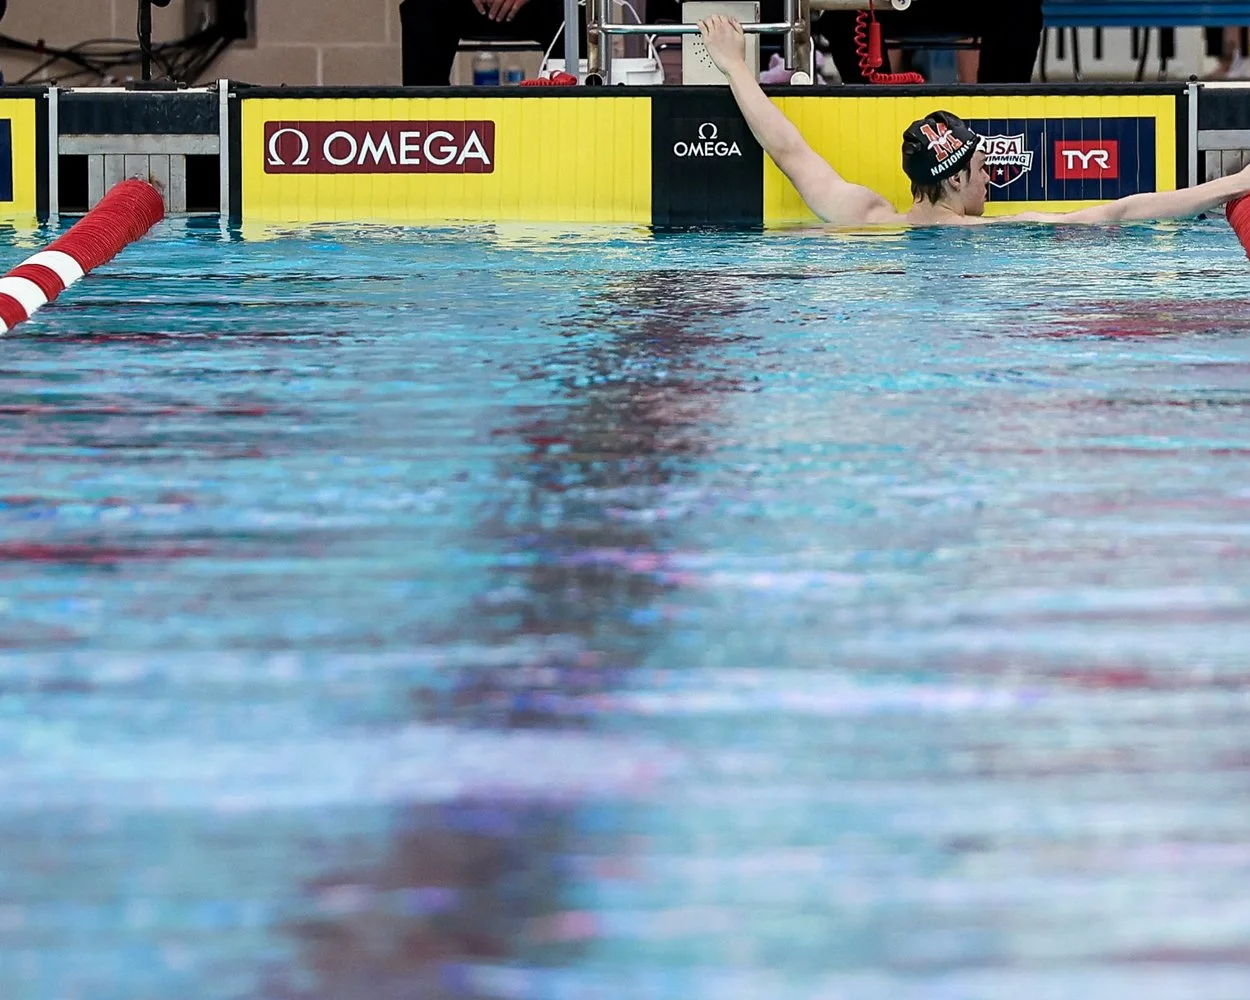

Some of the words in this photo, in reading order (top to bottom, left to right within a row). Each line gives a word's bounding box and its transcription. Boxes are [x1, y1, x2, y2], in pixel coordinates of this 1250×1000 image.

[322, 129, 491, 166] OMEGA
[673, 141, 742, 157] OMEGA
[930, 140, 973, 176] NATIONALS
[1062, 149, 1109, 169] TYR
